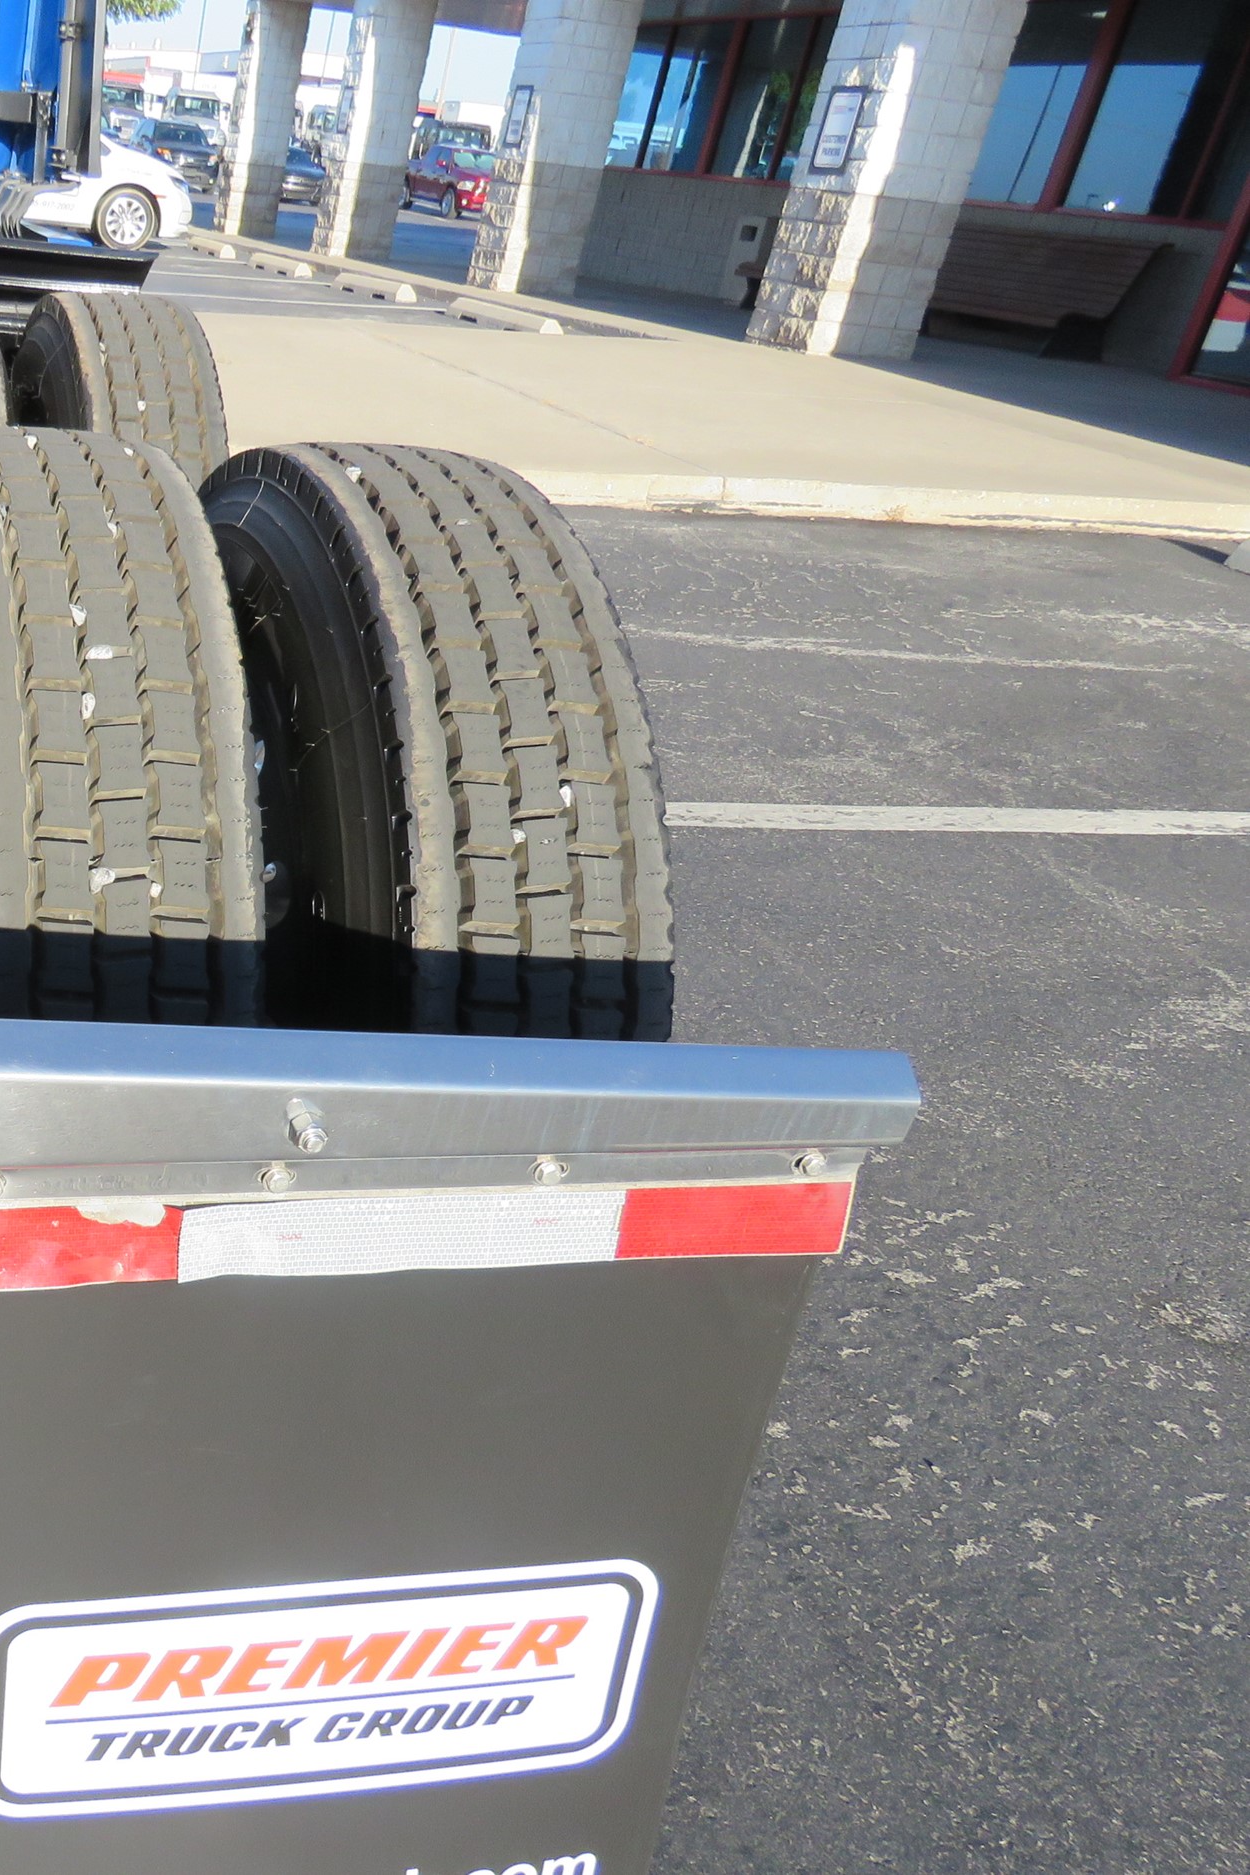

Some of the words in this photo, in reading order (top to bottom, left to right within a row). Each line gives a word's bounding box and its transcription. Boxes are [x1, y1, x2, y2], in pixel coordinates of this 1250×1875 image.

[49, 1615, 588, 1707] PREMIER
[85, 1716, 309, 1762] TRUCK
[314, 1695, 534, 1743] GROUP
